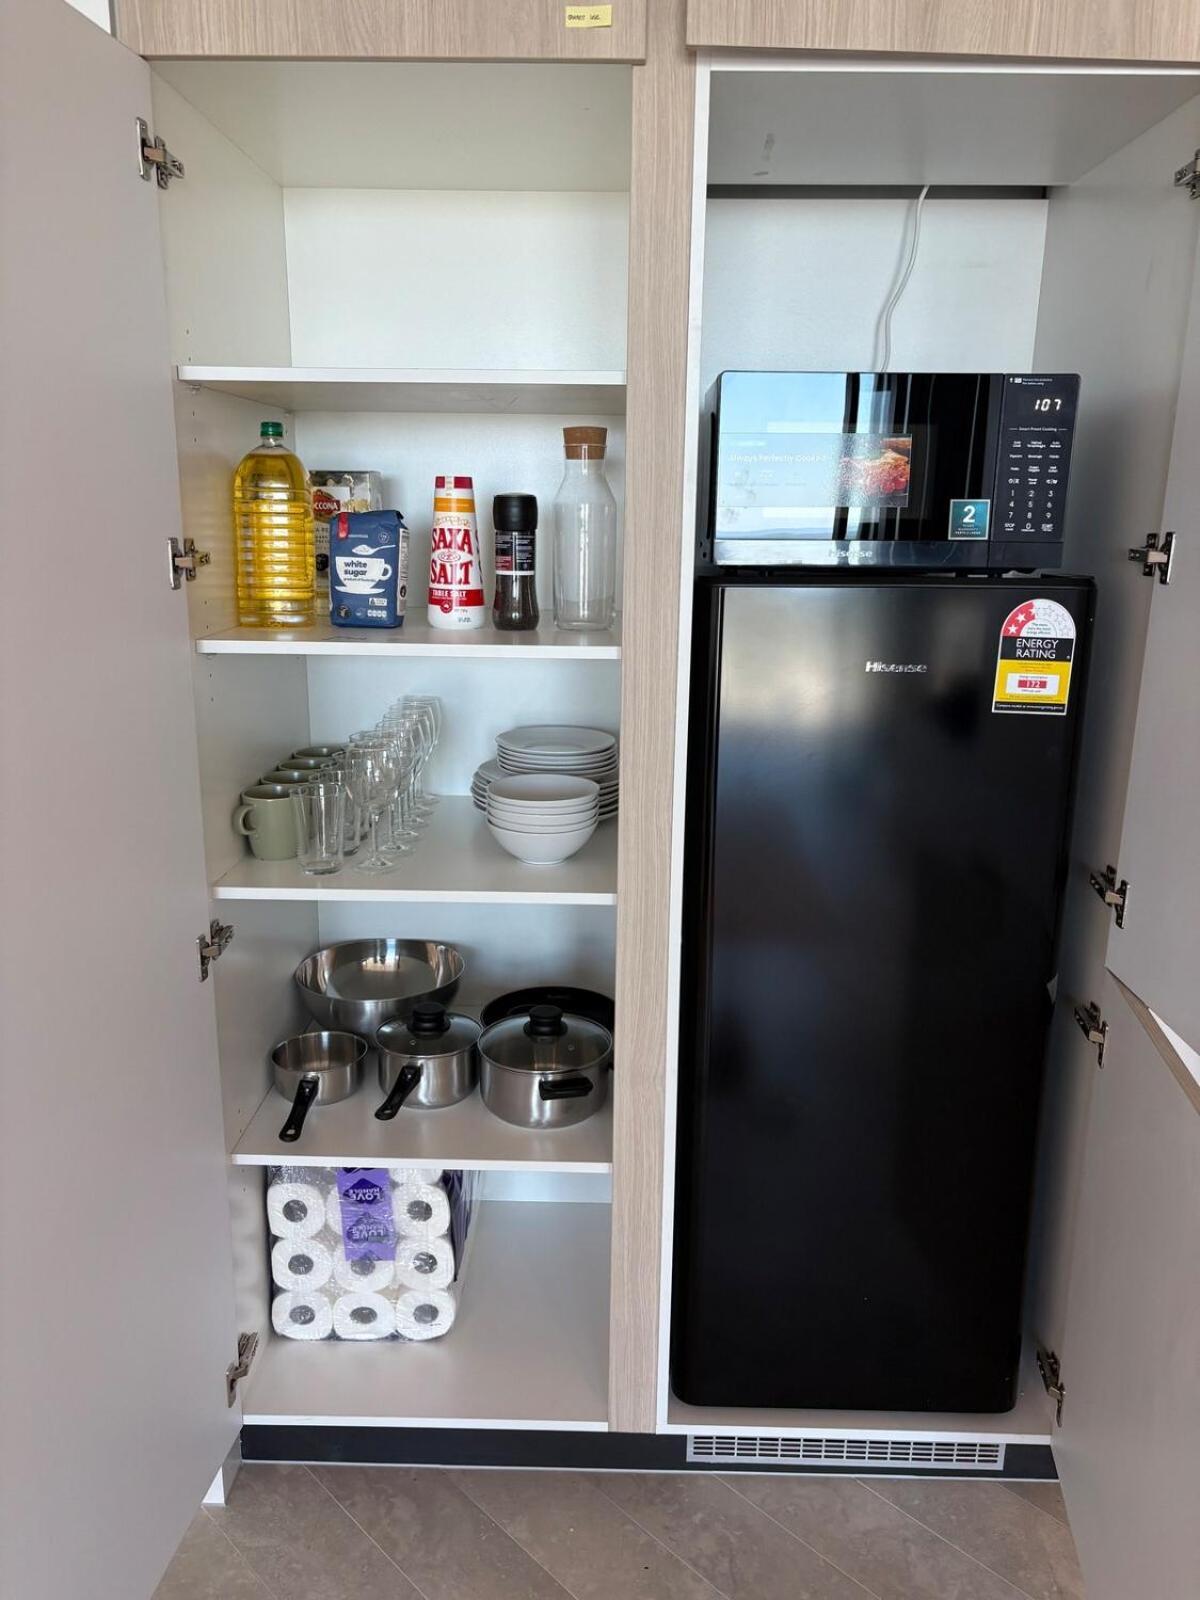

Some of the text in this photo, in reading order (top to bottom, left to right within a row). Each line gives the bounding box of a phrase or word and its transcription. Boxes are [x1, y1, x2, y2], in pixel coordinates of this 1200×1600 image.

[962, 505, 976, 523] 2
[431, 527, 474, 557] SAXA
[343, 560, 368, 568] white
[343, 569, 368, 578] sugar
[430, 558, 474, 585] SALT
[1015, 638, 1059, 649] ENERGY
[1015, 649, 1056, 659] RATING
